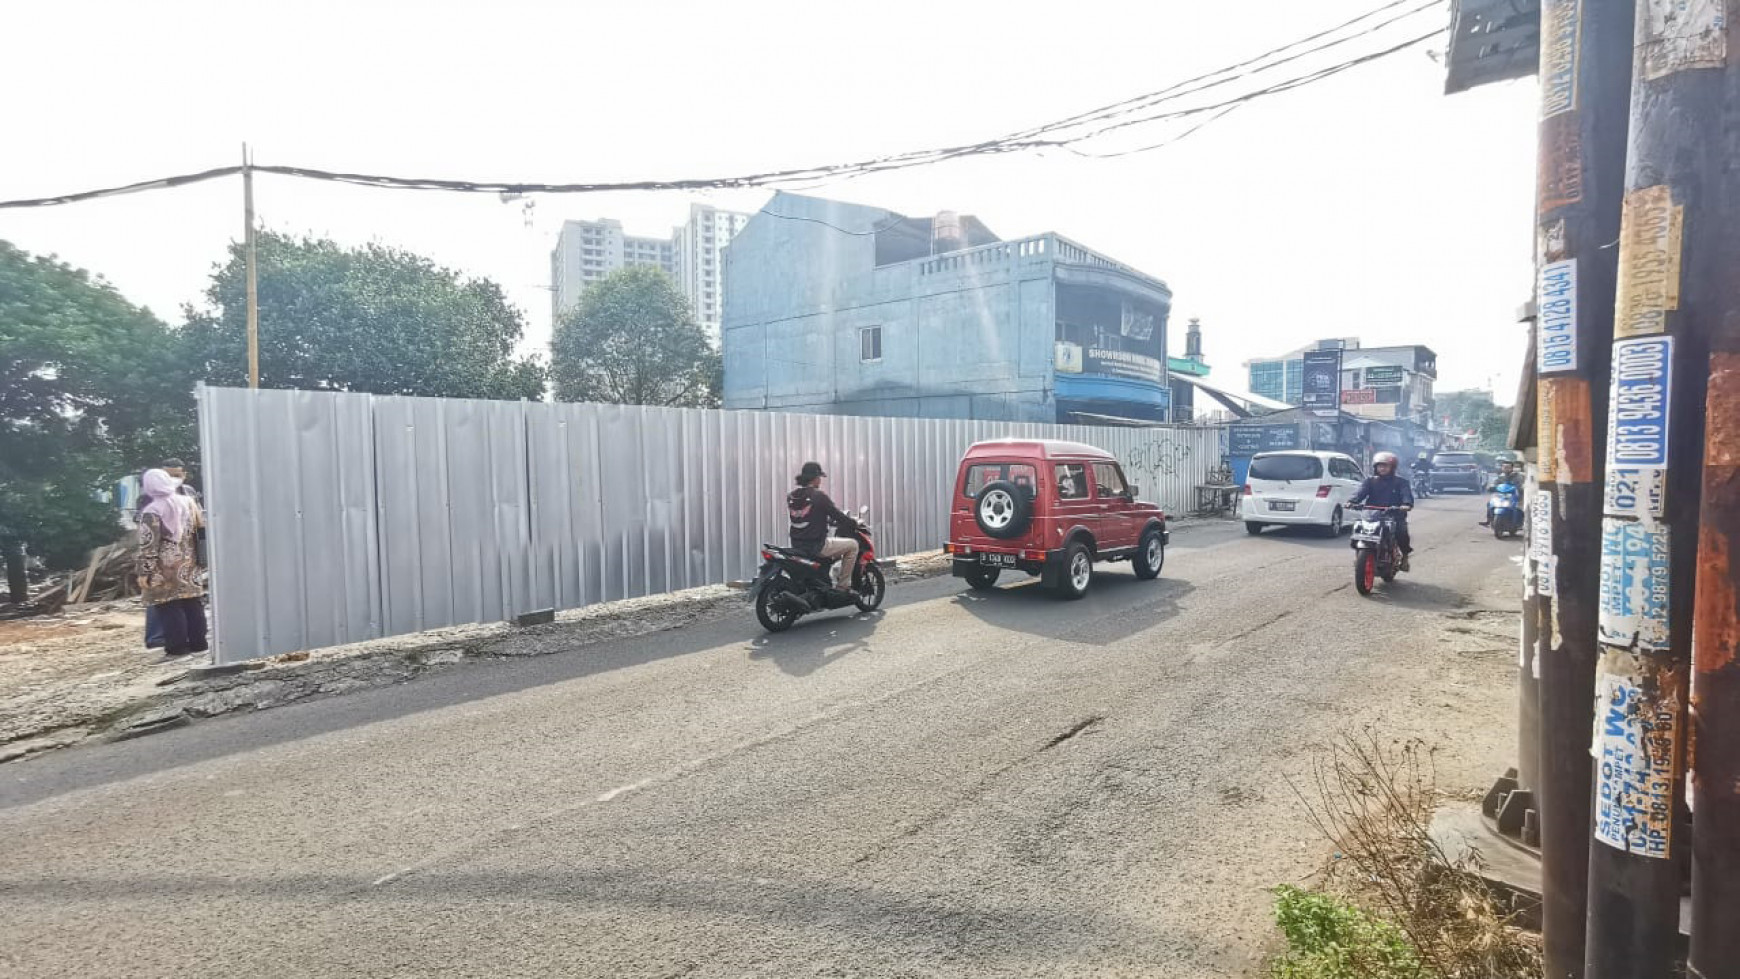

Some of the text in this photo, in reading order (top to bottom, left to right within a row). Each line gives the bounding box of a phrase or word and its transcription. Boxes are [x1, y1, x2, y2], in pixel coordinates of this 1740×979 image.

[1542, 264, 1571, 366] 0815 4128 4341
[1616, 344, 1664, 459] 0813 9436 0003
[1652, 526, 1668, 561] 5225
[1651, 566, 1668, 602] 9879
[1599, 684, 1627, 837] SEDOT WC
[1650, 782, 1670, 822] 0813
[1650, 828, 1667, 852] HP.
